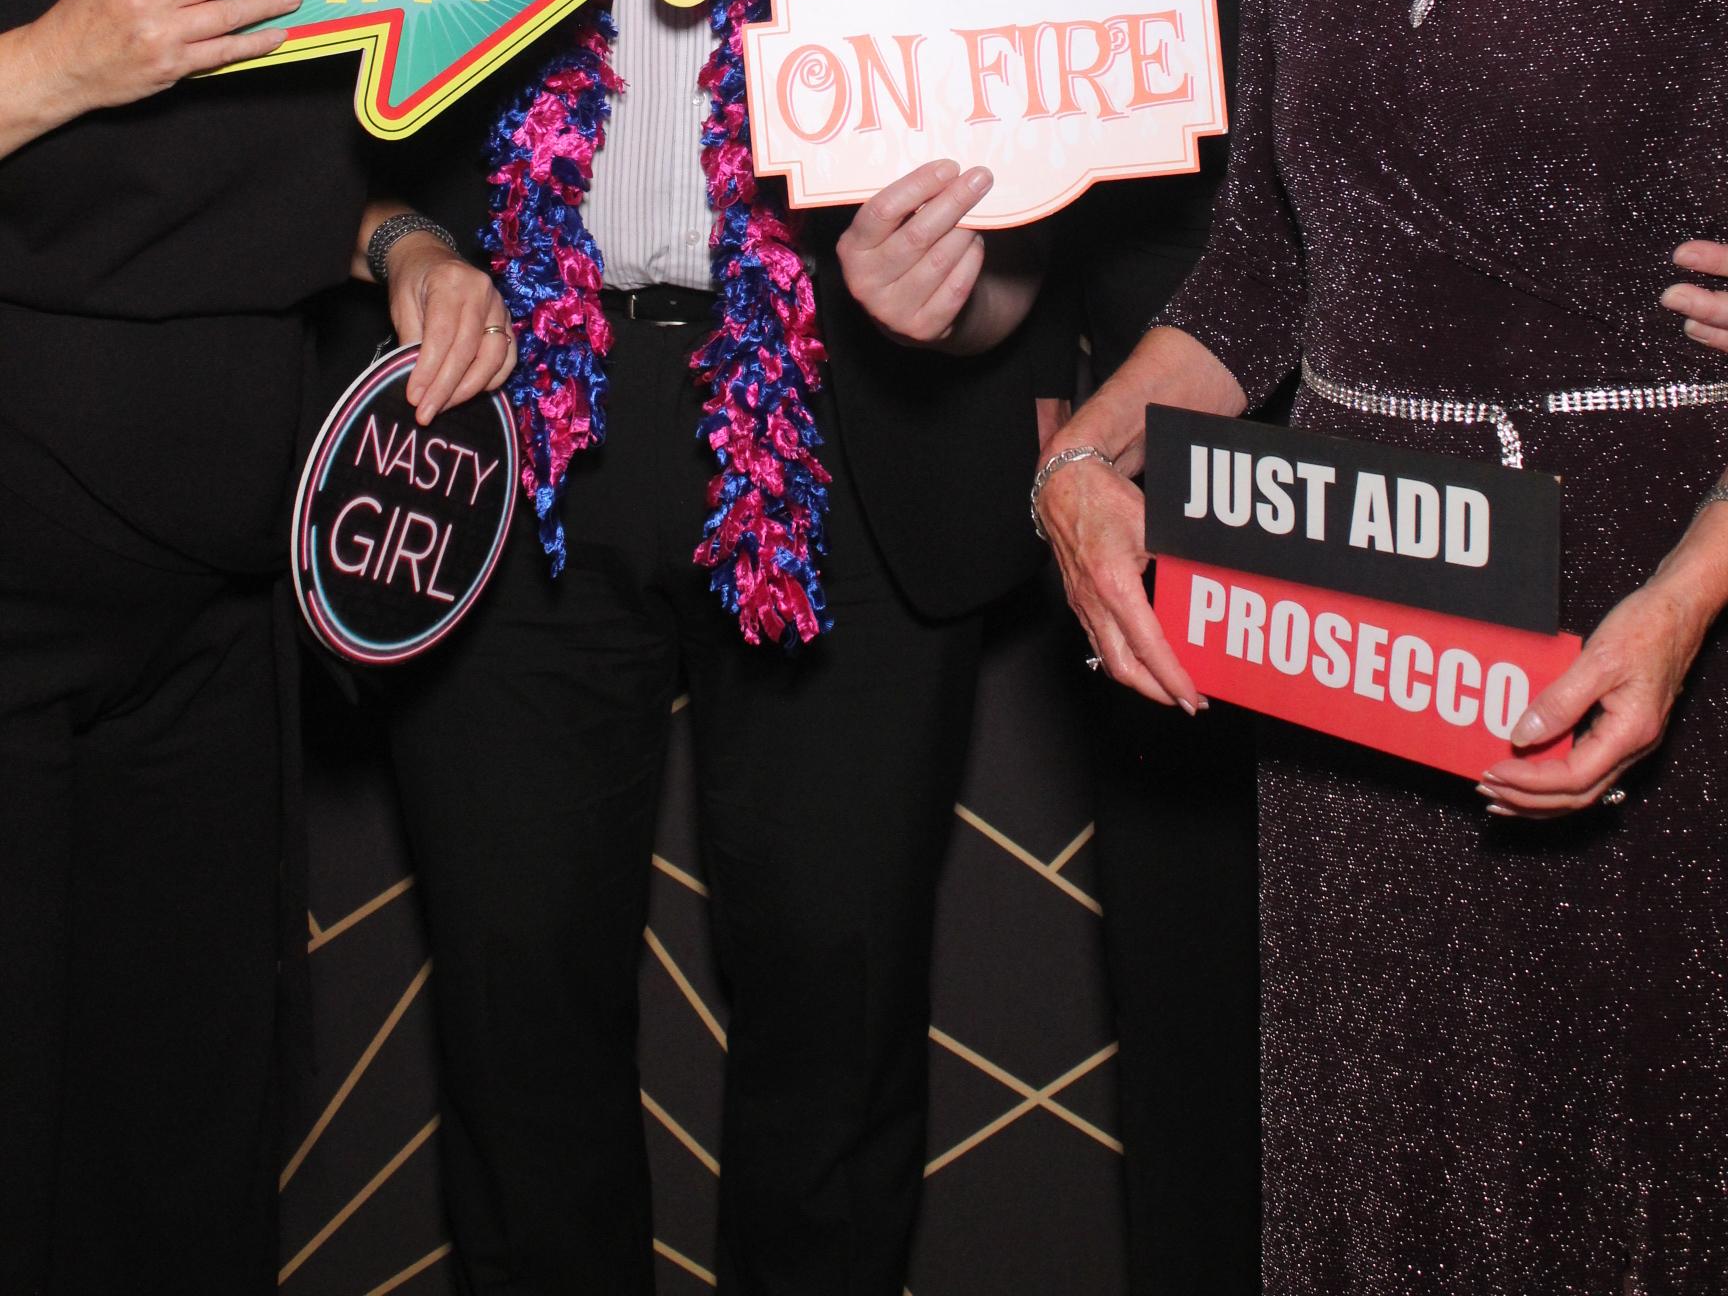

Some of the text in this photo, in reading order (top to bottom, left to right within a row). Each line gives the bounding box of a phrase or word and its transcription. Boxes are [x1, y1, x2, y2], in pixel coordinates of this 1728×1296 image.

[775, 8, 1195, 145] ON FIRE
[354, 413, 499, 506] NASTY
[1183, 444, 1491, 568] JUST ADD
[329, 495, 456, 602] GIRL
[1186, 573, 1531, 741] PROSECCO
